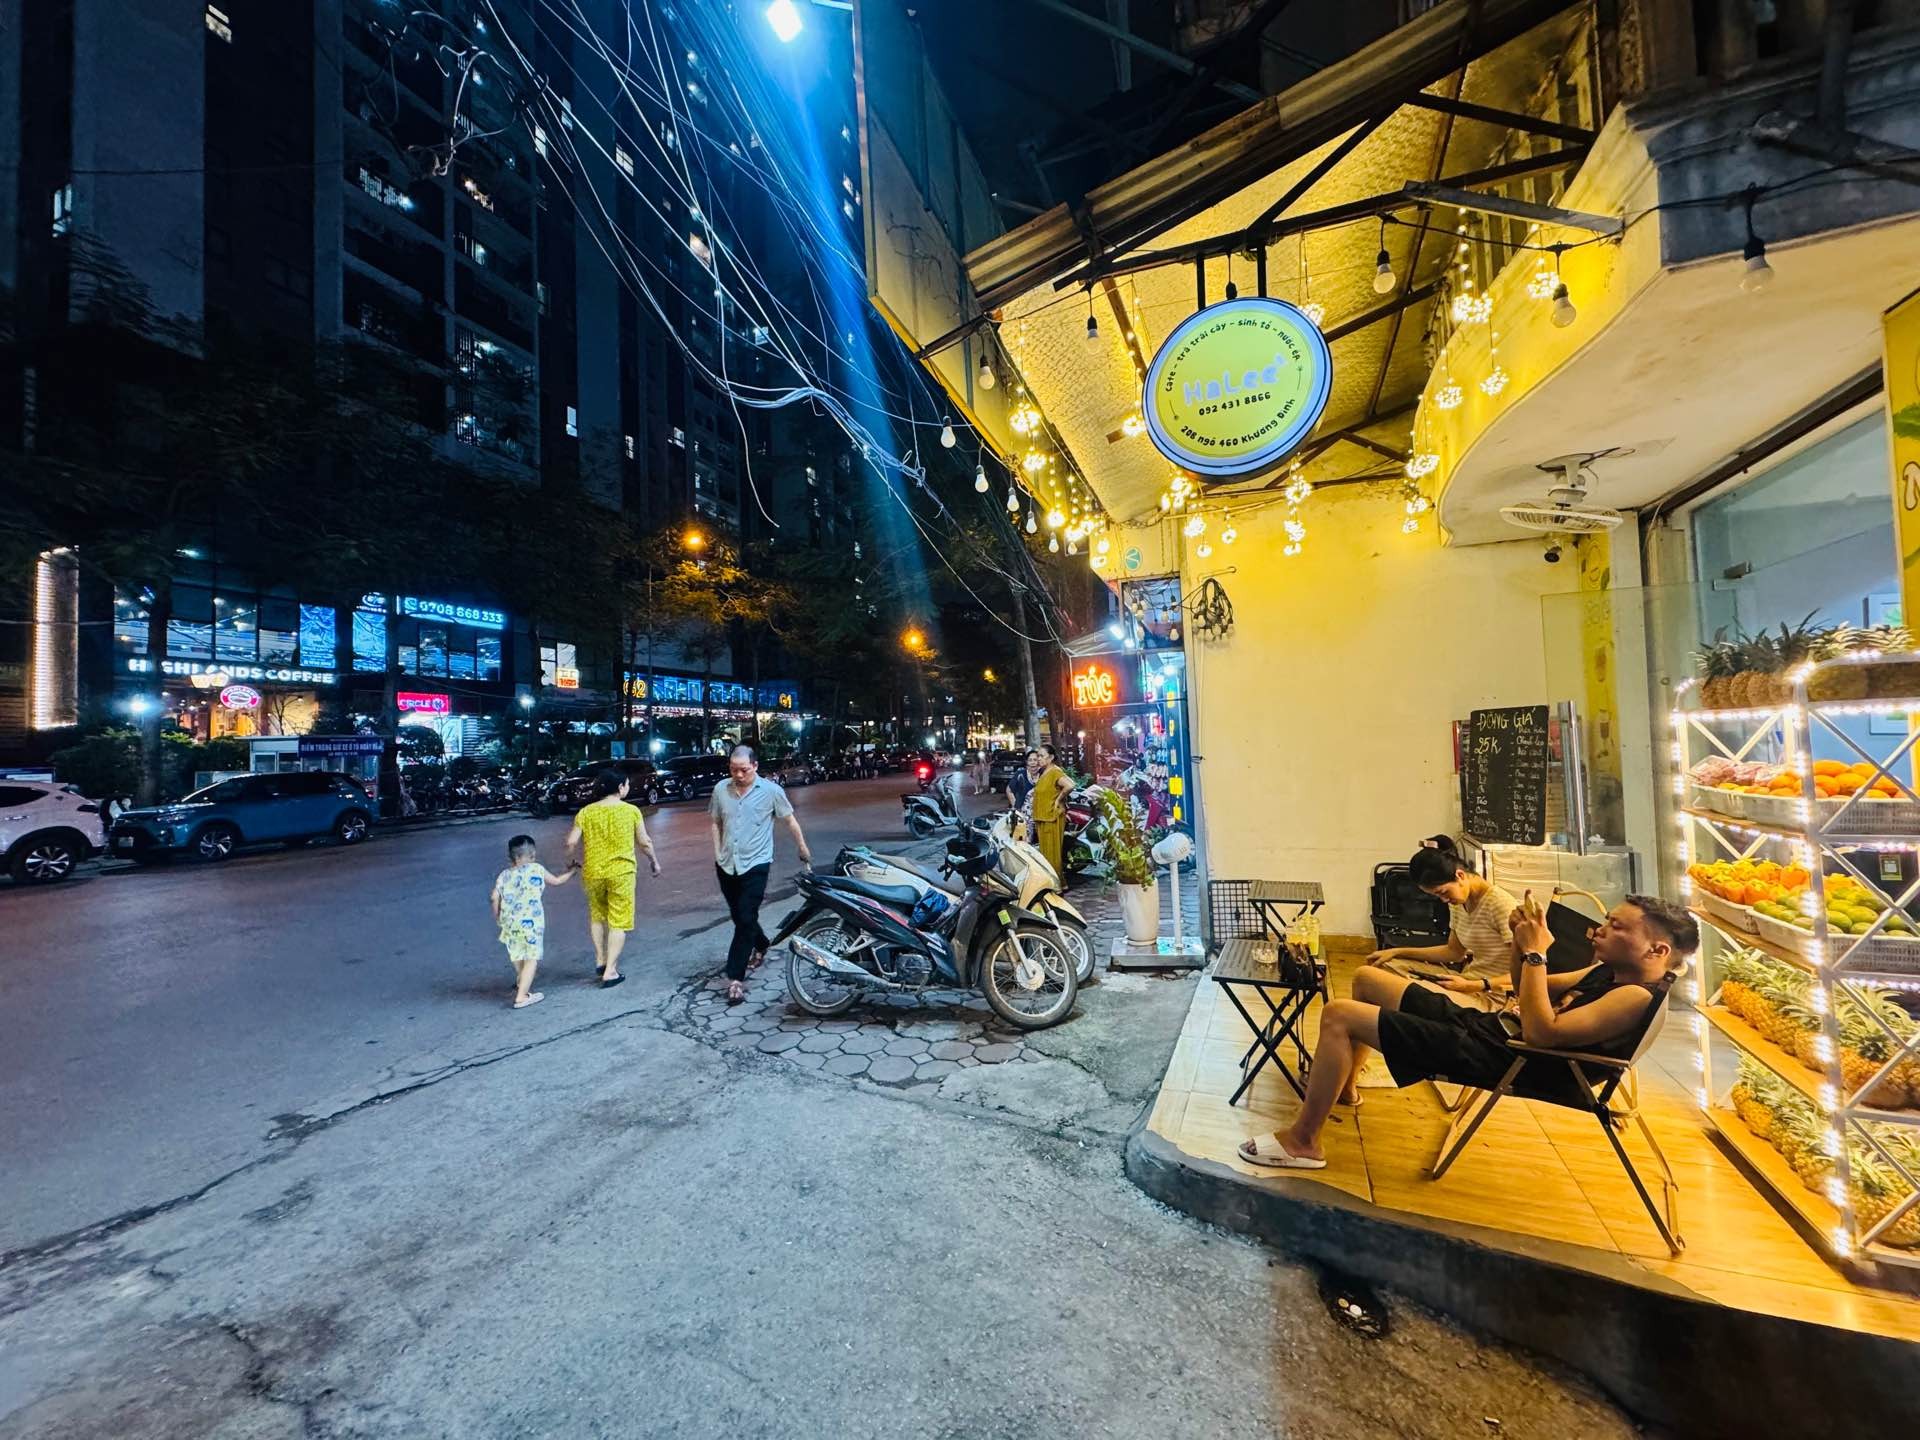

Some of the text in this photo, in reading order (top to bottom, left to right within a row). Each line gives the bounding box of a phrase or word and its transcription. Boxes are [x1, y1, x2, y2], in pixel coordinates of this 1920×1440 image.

[1238, 319, 1257, 327] sinh
[1198, 391, 1271, 416] 092 431 8866
[1219, 438, 1239, 448] 460
[419, 600, 503, 623] 0708 868 333
[265, 669, 335, 684] COFFEE
[1074, 665, 1113, 704] TÓC
[1513, 707, 1536, 728] GIÁ
